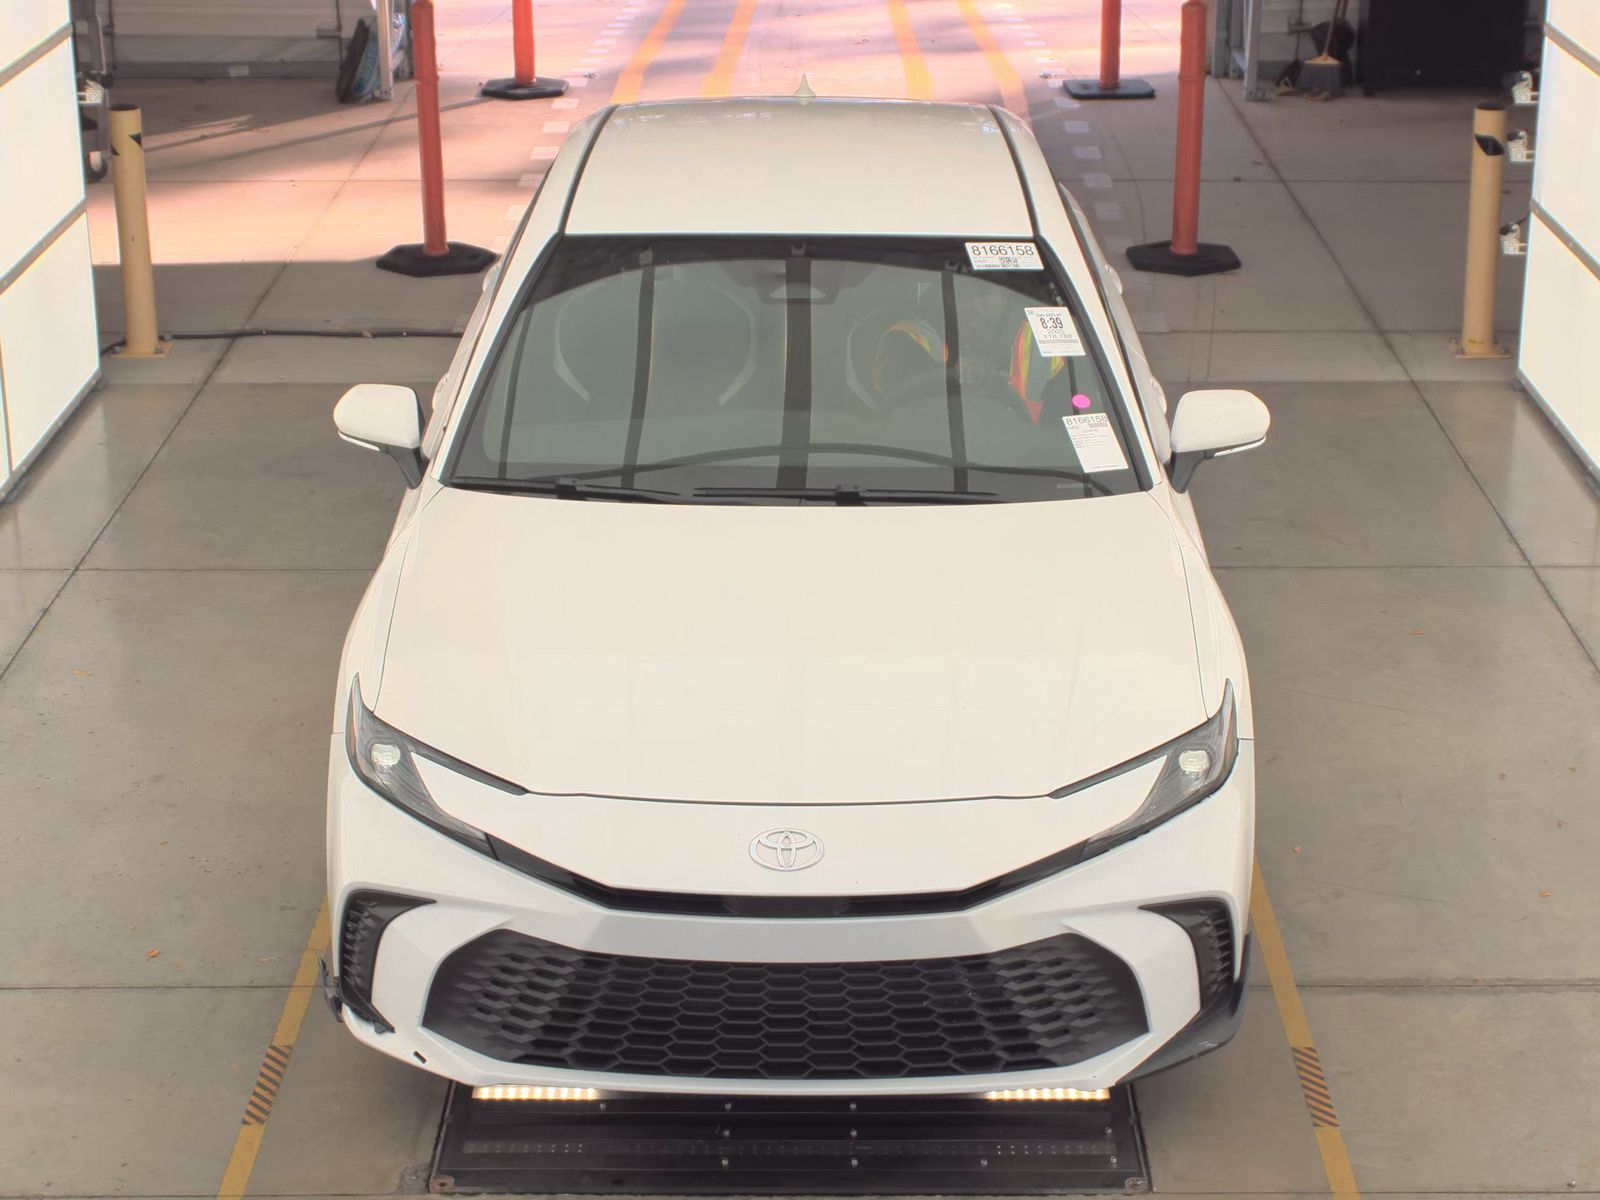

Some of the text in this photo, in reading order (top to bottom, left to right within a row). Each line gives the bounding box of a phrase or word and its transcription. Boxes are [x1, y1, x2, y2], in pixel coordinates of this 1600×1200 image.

[971, 245, 1034, 256] 8166158
[1040, 317, 1063, 329] 8:39
[1066, 415, 1107, 425] 8166158
